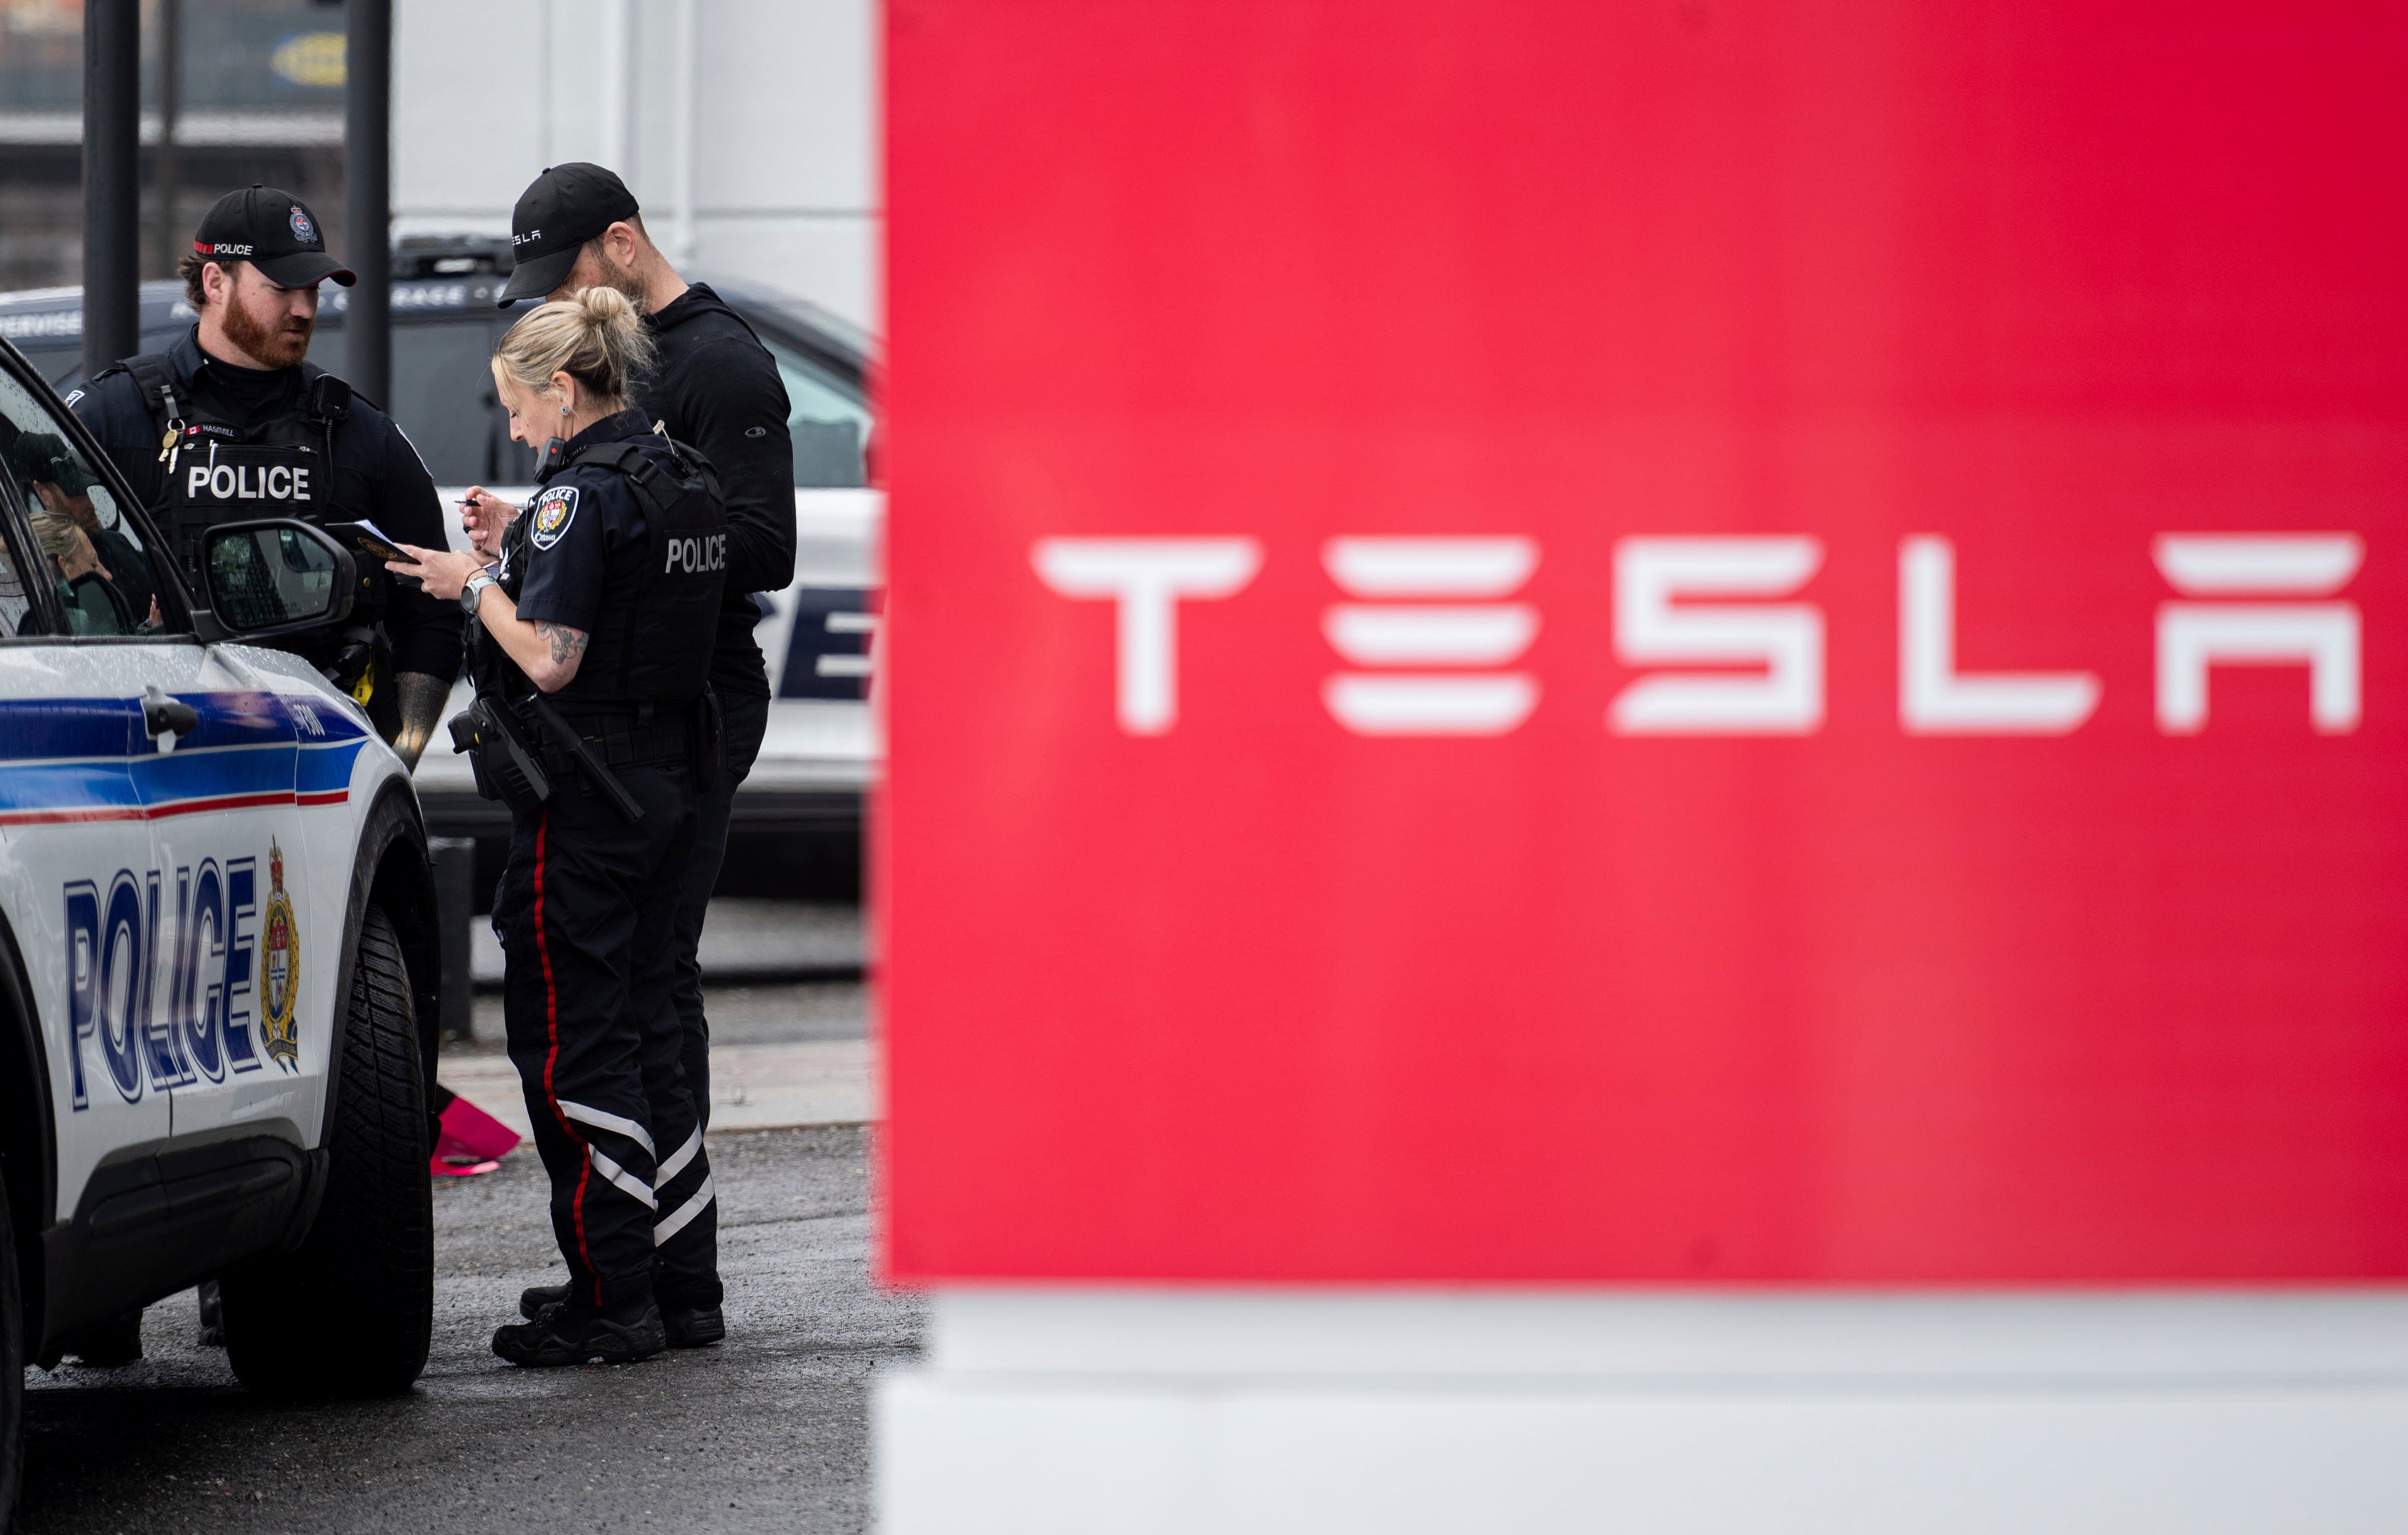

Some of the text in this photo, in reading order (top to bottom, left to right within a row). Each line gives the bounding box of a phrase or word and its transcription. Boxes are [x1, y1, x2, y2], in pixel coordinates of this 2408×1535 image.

[214, 243, 254, 255] POLICE
[188, 465, 311, 500] POLICE
[542, 489, 573, 507] POLICE
[665, 534, 726, 574] POLICE
[1030, 533, 2364, 736] TESLA
[63, 856, 262, 1112] POLICE
